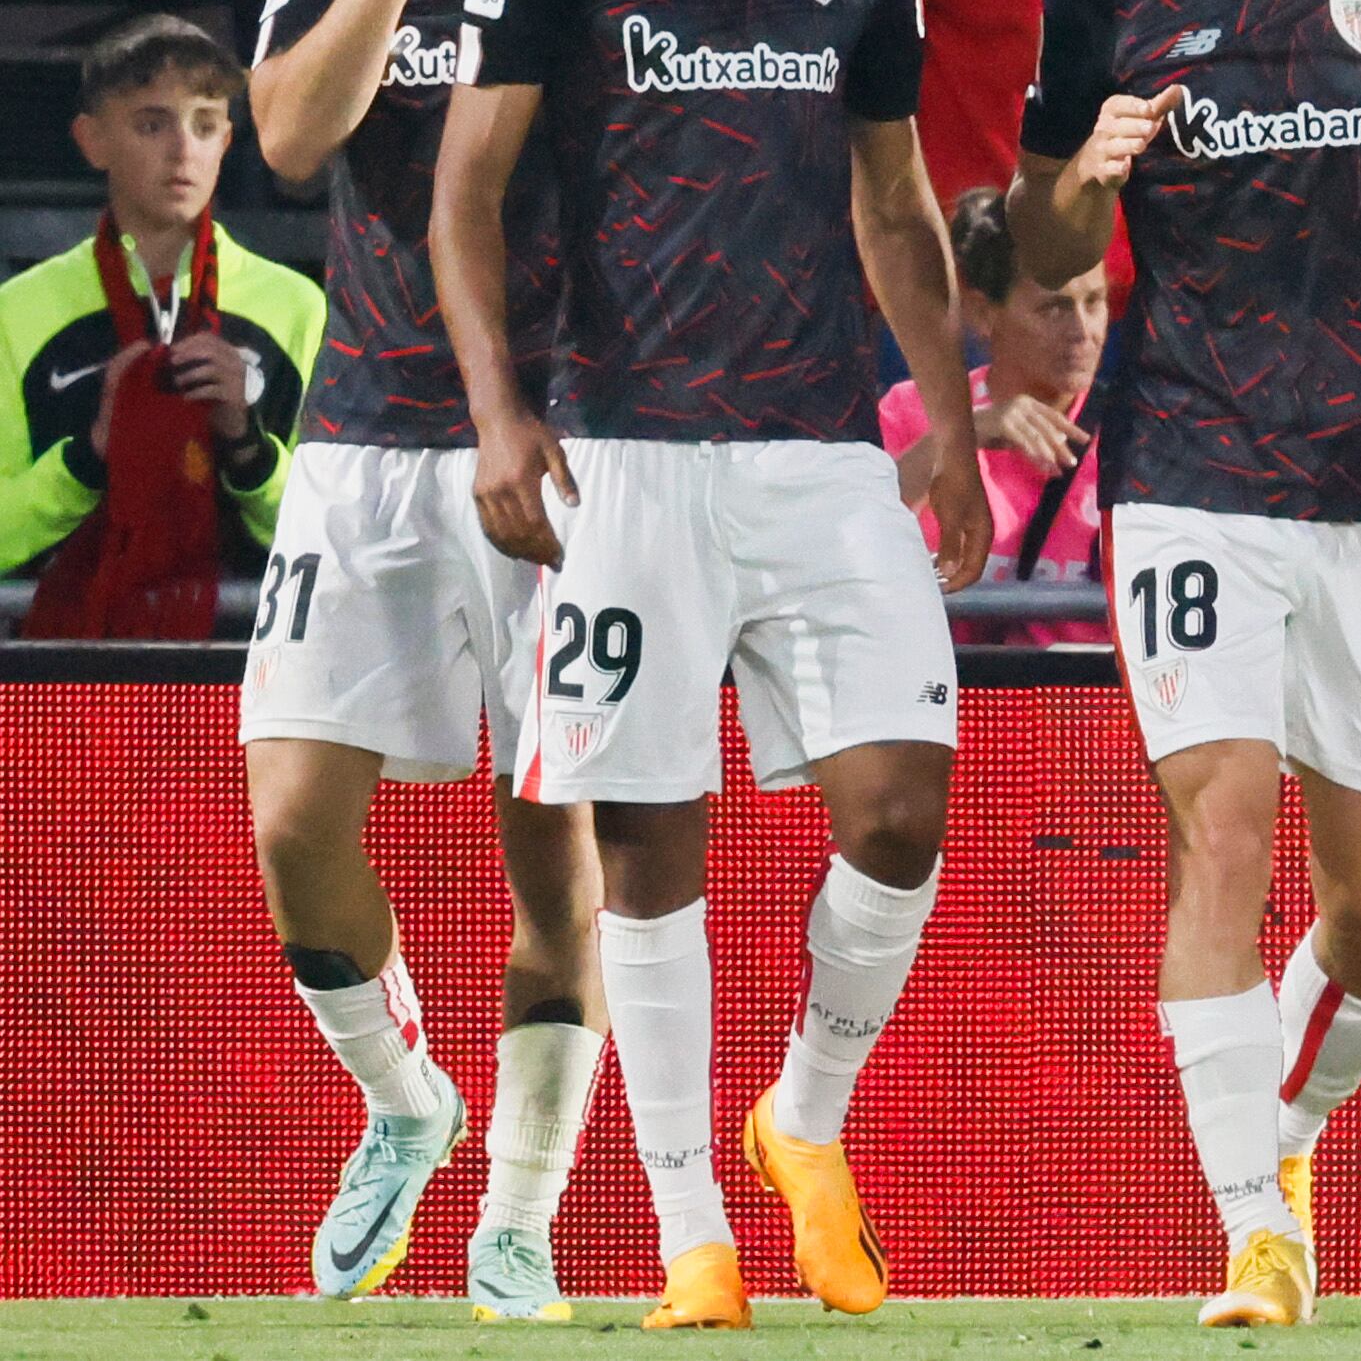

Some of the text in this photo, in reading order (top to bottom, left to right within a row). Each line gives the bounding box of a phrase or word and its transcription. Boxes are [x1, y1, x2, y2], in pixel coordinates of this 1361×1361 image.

[622, 15, 839, 93] Kutxabank
[254, 551, 323, 644] 31
[1128, 559, 1220, 663] 18
[544, 601, 644, 707] 29
